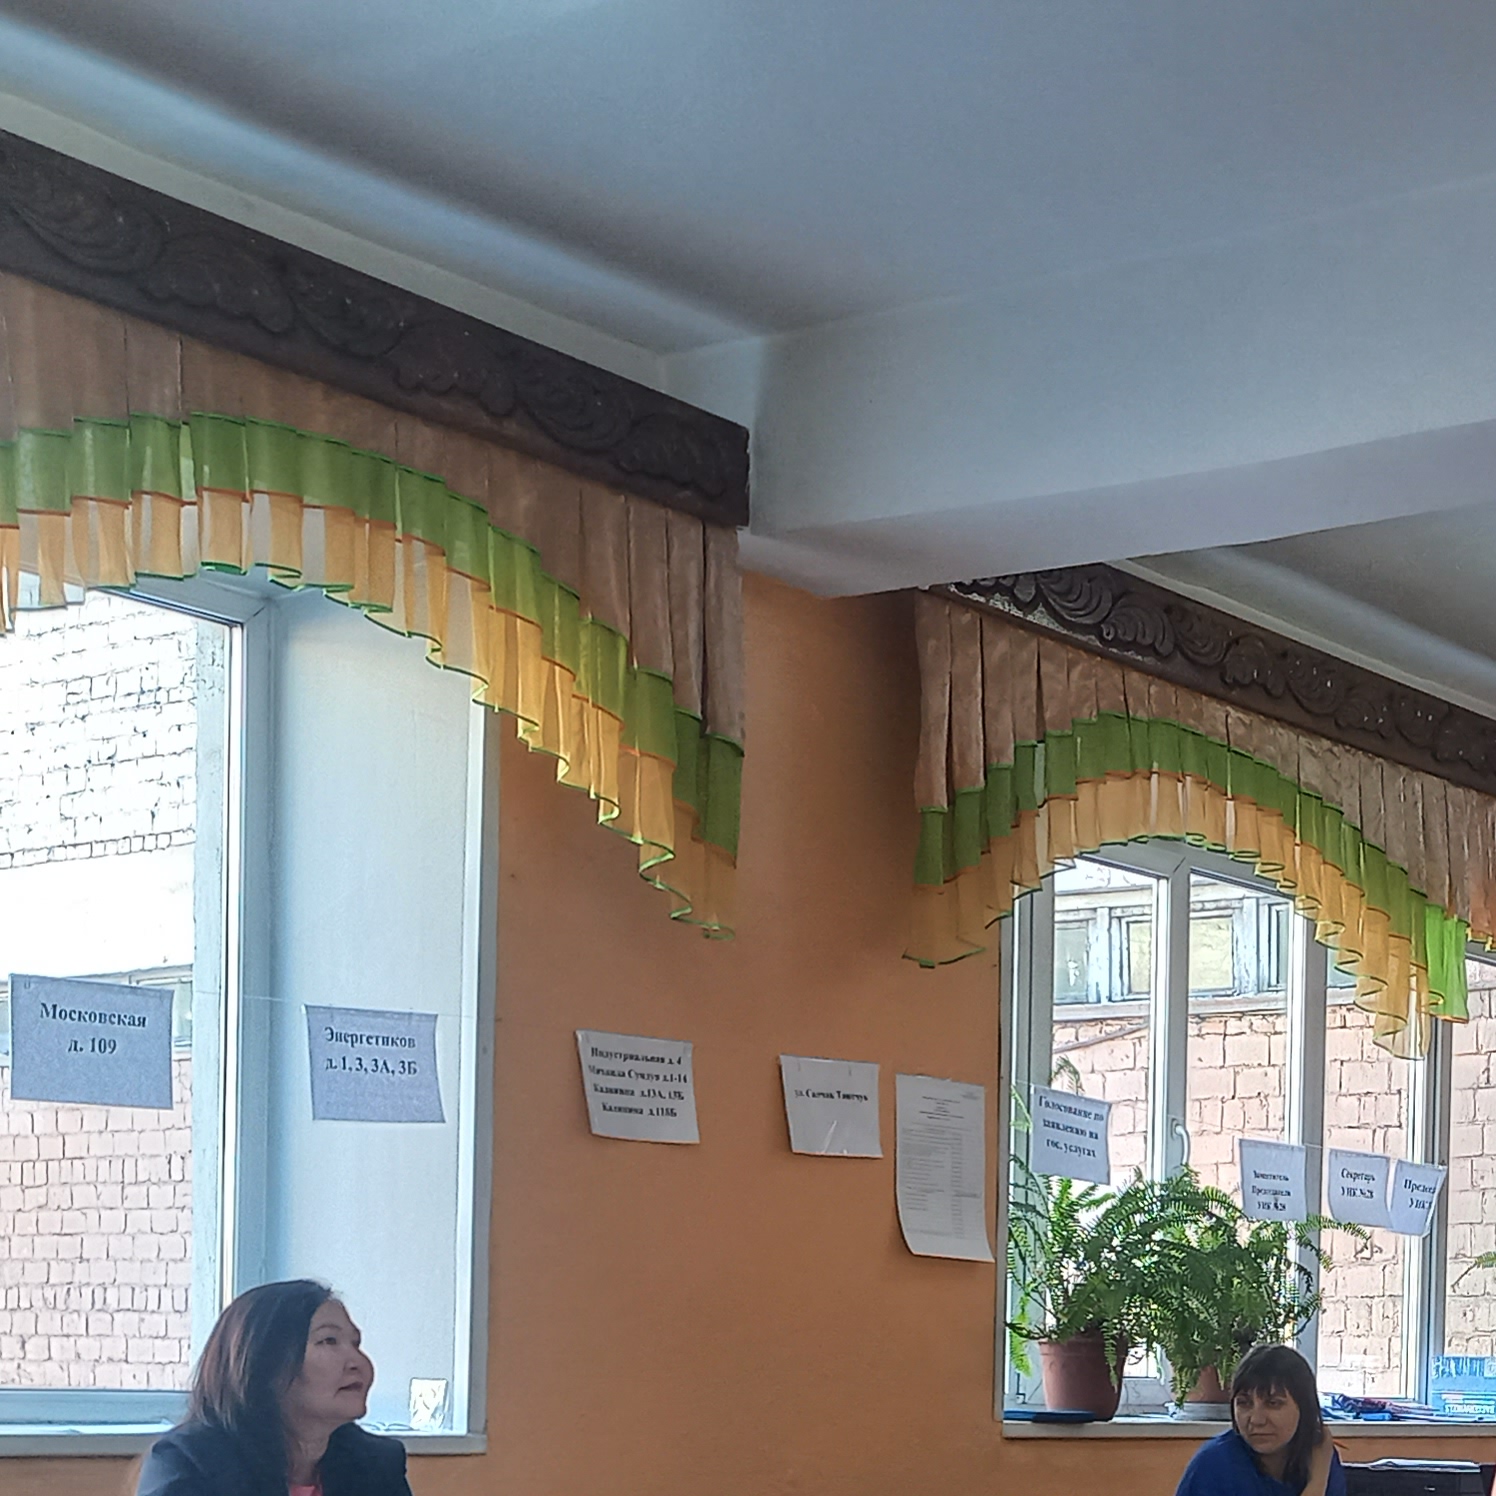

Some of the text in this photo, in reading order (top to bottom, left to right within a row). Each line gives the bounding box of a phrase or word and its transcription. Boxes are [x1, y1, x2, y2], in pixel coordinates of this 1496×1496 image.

[40, 1002, 147, 1028] Московская
[67, 1037, 117, 1054] д. 109
[324, 1026, 416, 1049] Энергетиков
